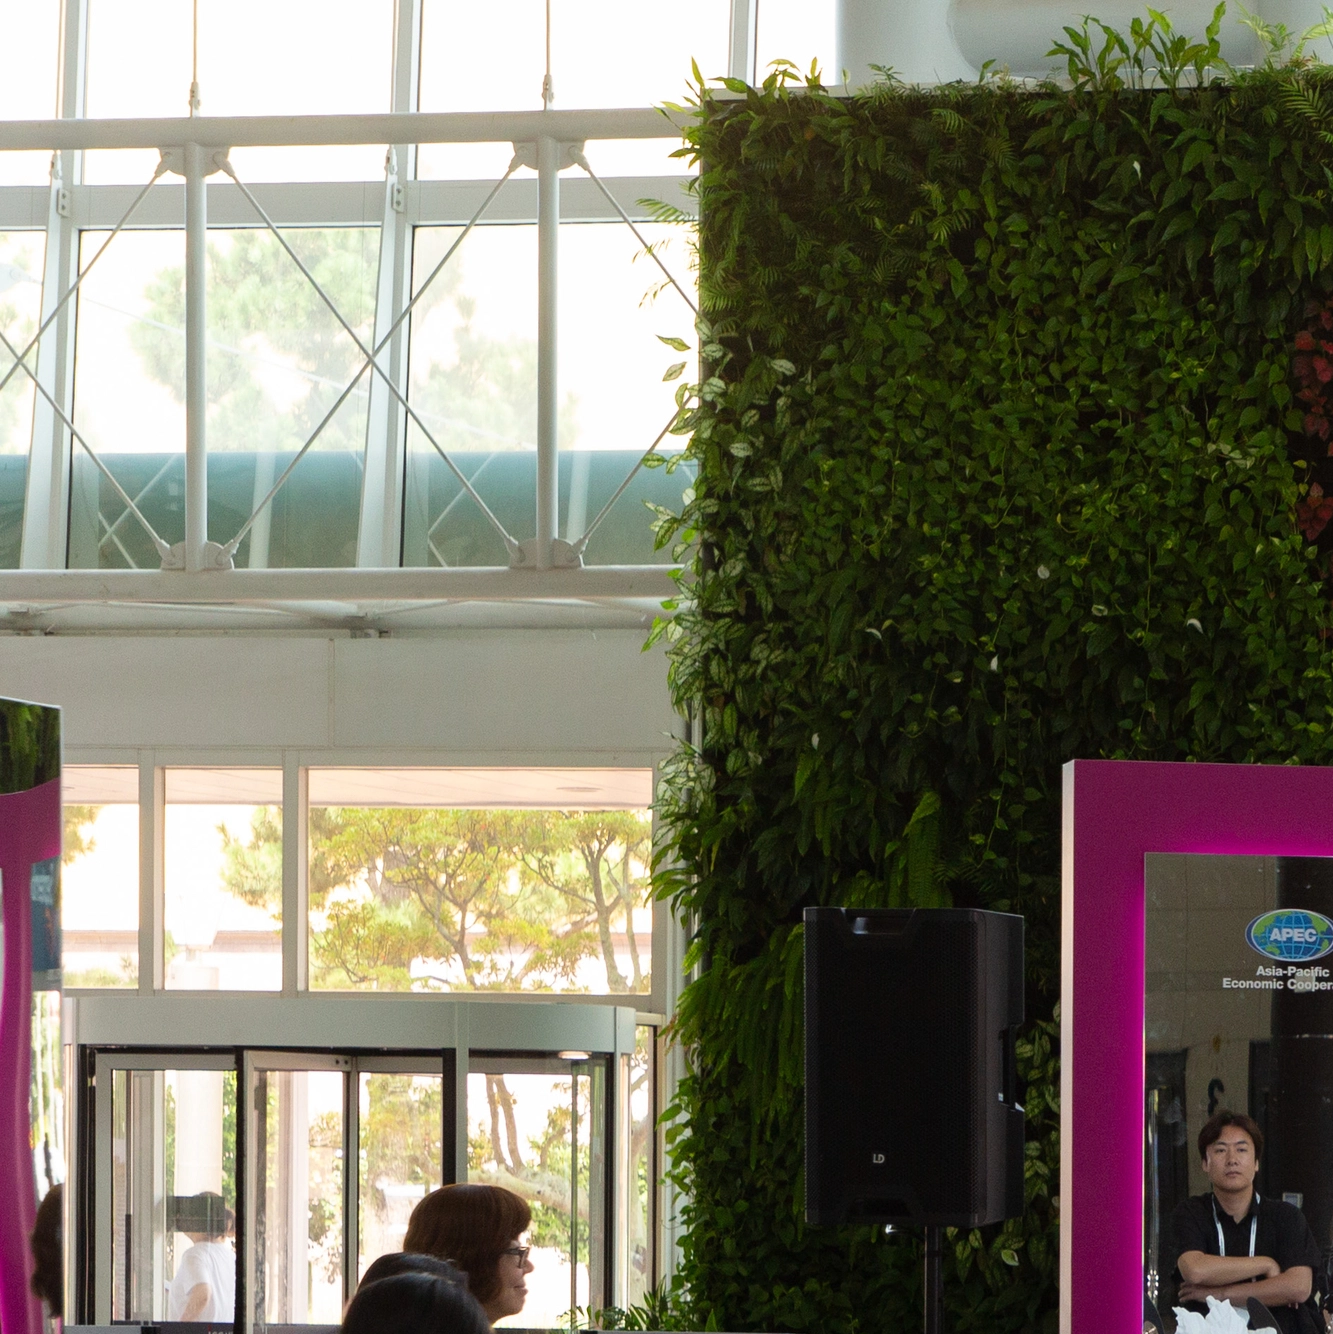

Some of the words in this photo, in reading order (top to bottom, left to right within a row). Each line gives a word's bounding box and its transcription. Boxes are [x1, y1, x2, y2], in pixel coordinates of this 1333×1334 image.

[1269, 928, 1318, 942] APEC
[1255, 965, 1330, 977] Asia-Pacific
[1222, 977, 1284, 990] Economic
[873, 1153, 885, 1164] LD
